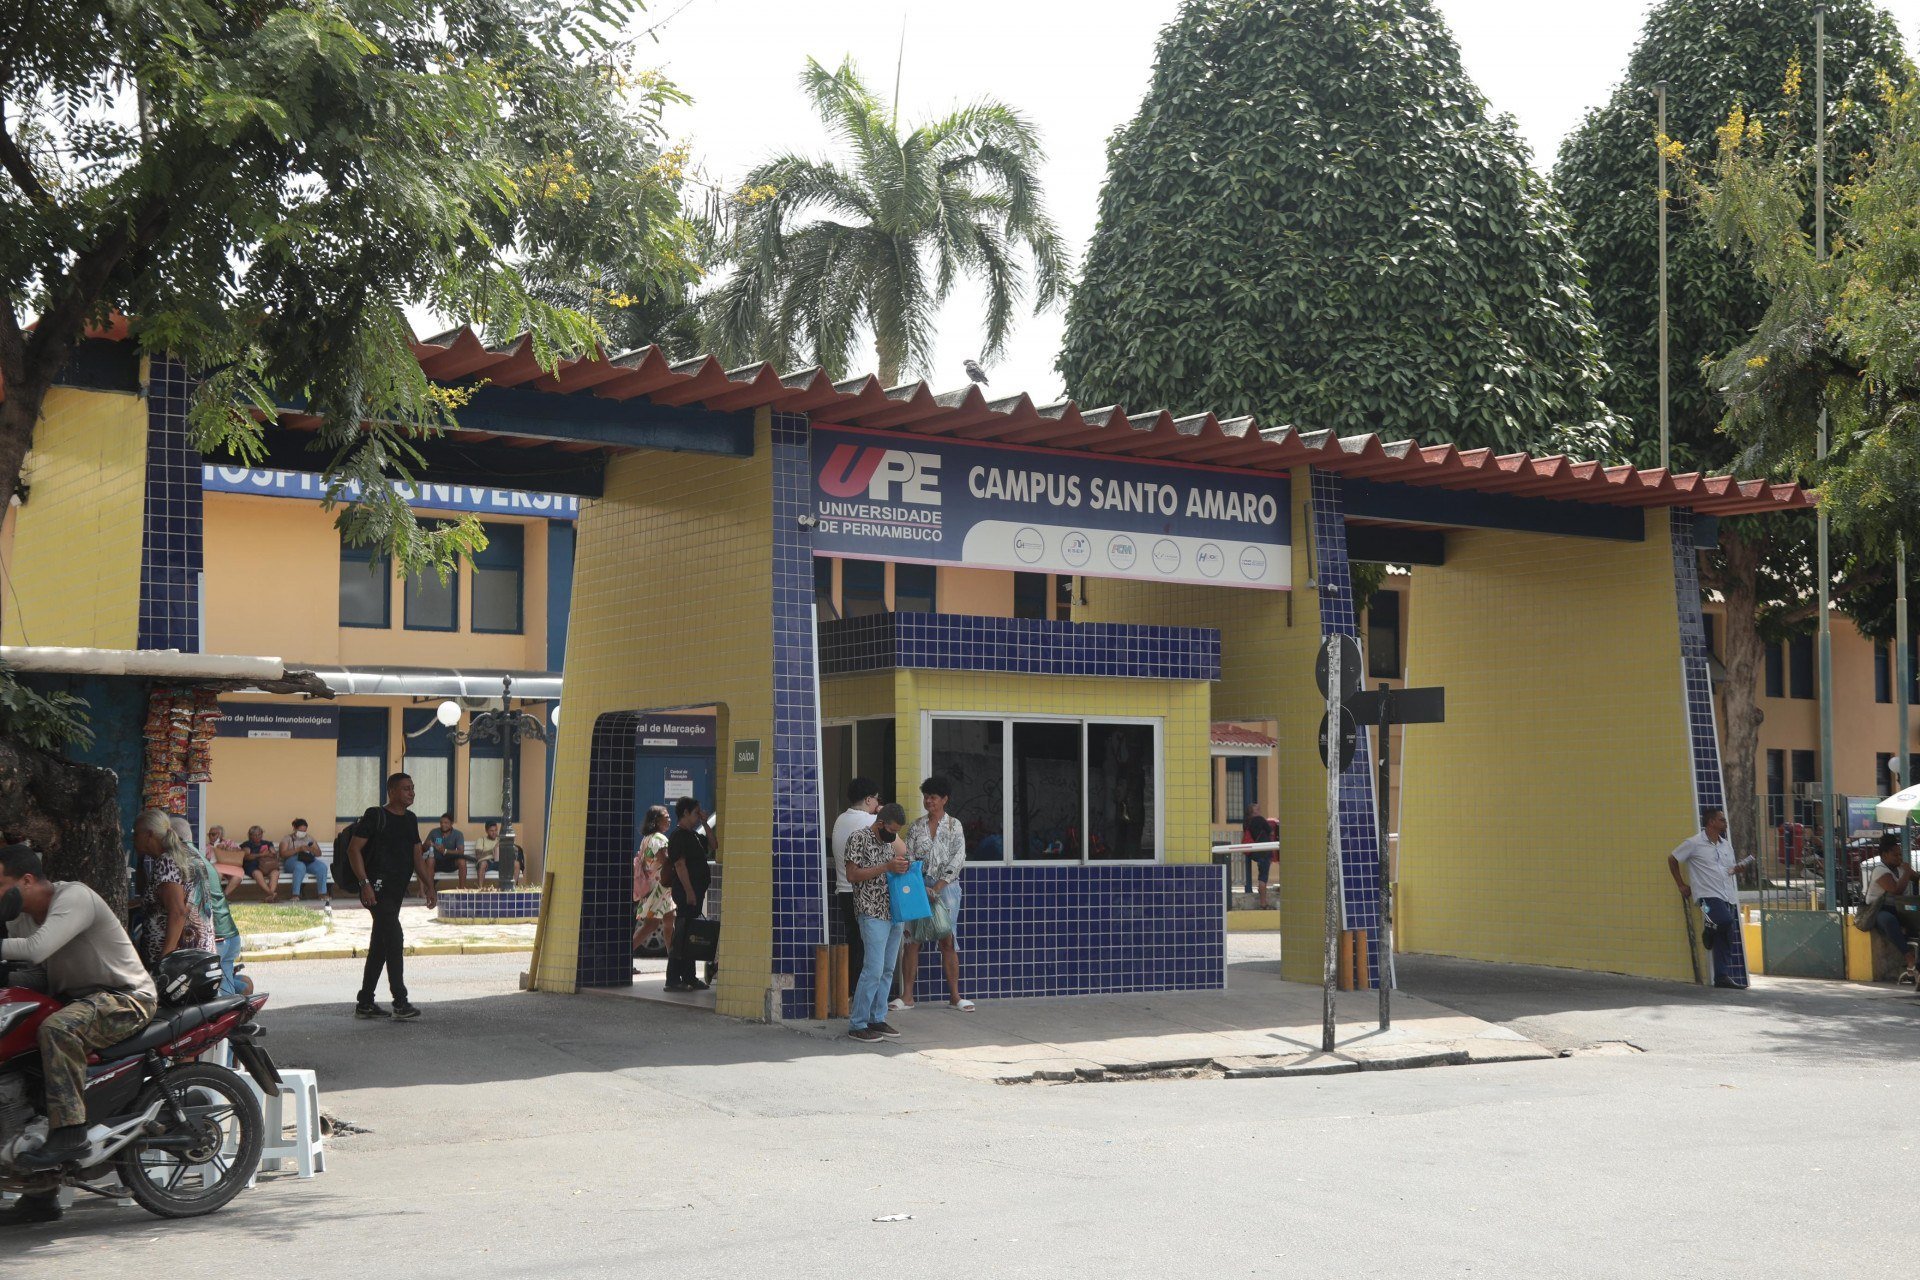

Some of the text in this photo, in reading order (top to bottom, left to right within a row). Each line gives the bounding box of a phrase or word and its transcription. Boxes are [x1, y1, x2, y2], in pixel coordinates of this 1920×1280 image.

[818, 443, 942, 506] UPE
[968, 465, 1277, 525] CAMPUS SANTO AMARO
[819, 501, 942, 524] UNIVERSIDADE
[819, 520, 943, 542] DE PERNAMBUCO
[234, 714, 244, 722] de
[245, 714, 274, 723] Infusão
[275, 715, 332, 725] Imunobiológica
[649, 723, 661, 732] de
[663, 724, 706, 736] Marcação
[738, 749, 755, 762] SAÍDA
